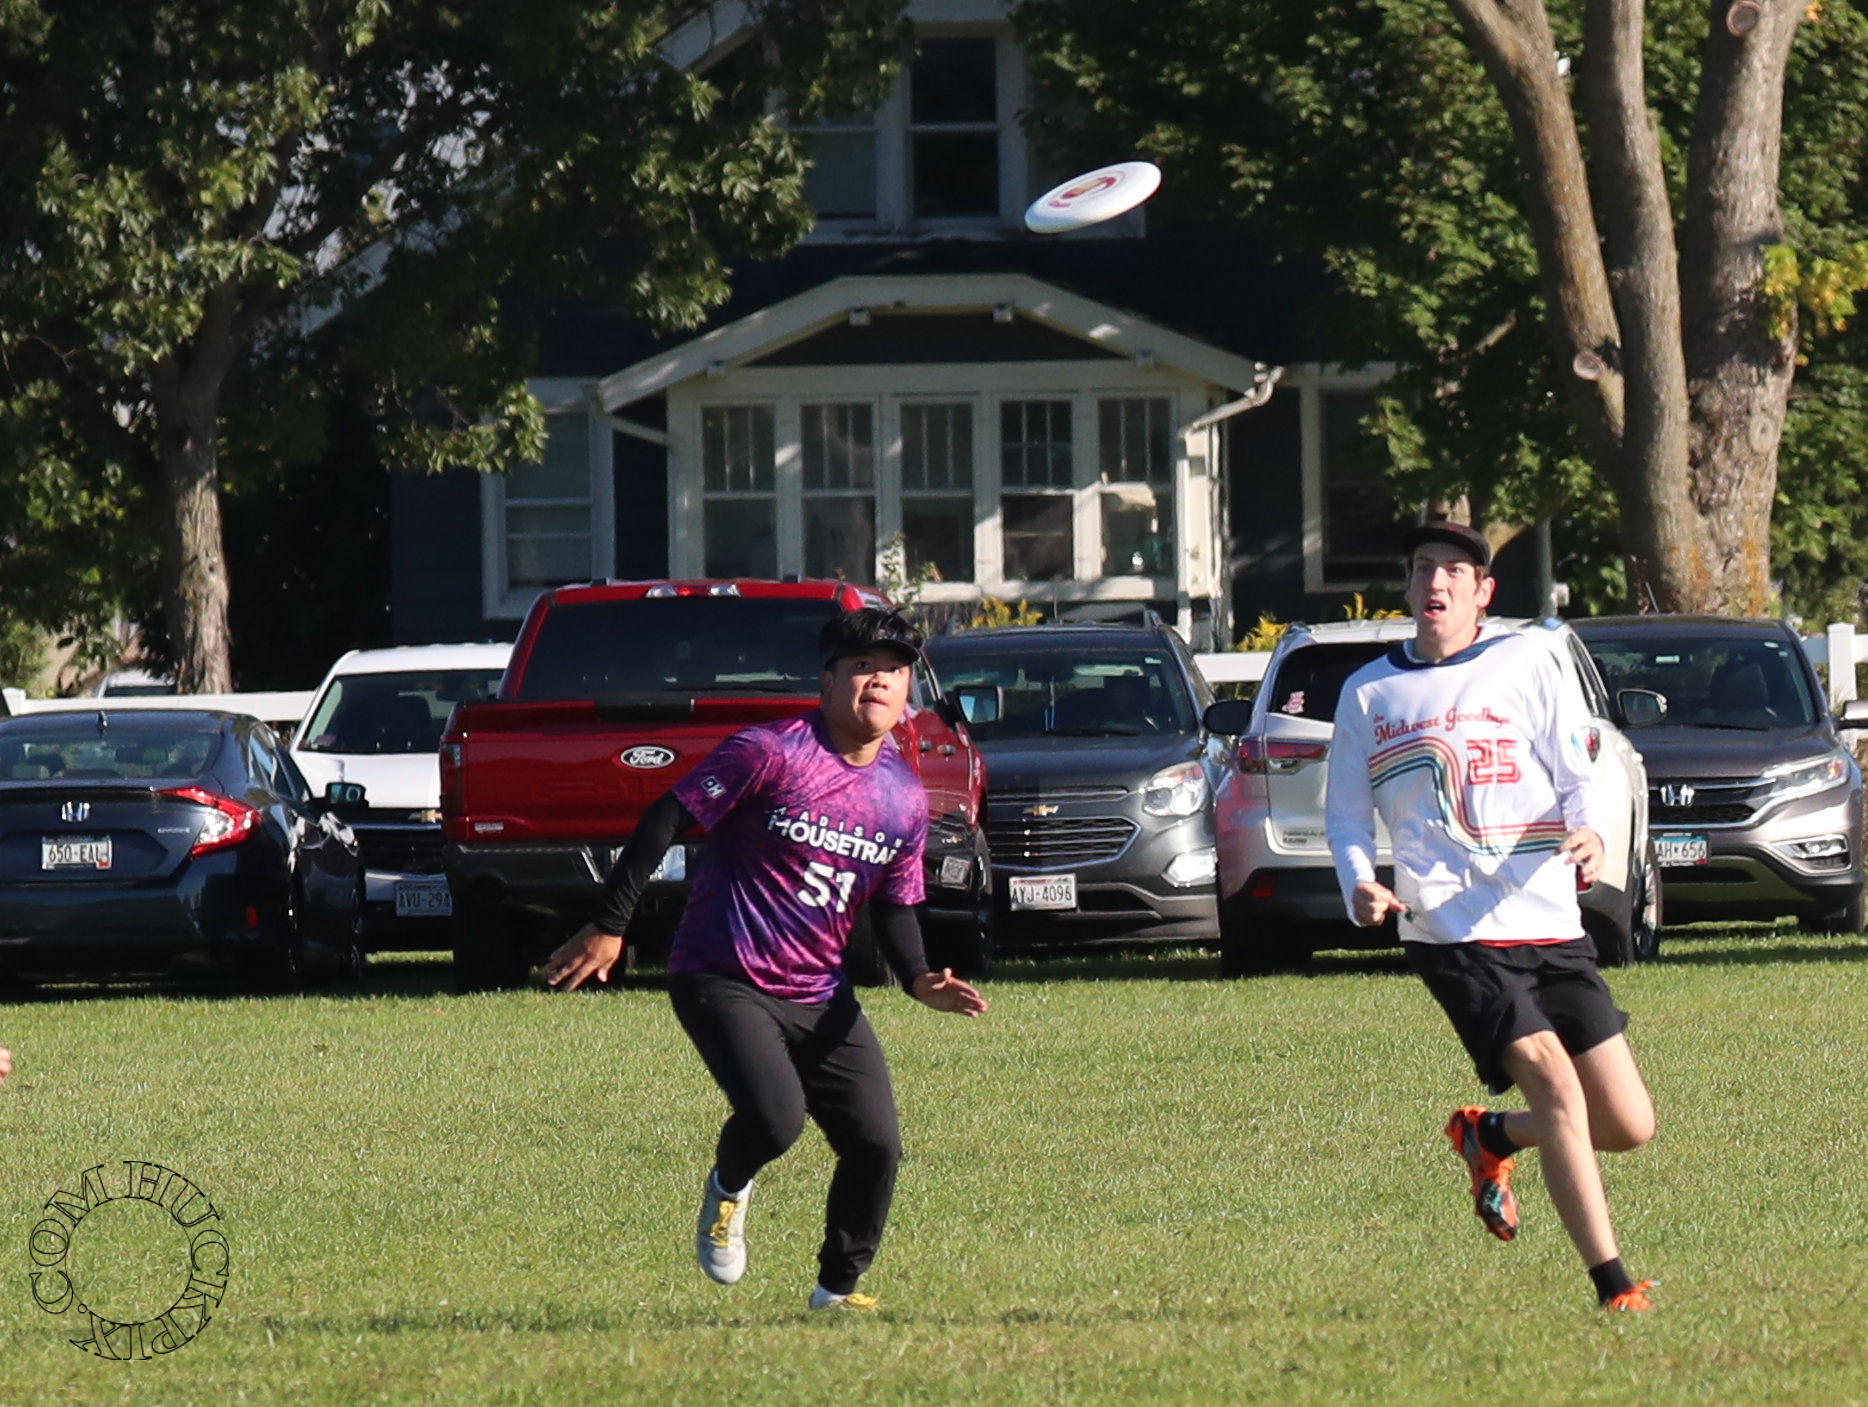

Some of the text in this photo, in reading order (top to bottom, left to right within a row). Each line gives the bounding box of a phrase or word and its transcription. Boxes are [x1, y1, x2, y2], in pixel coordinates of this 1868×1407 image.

[1374, 715, 1440, 745] Midwest
[628, 749, 666, 767] Ford
[1466, 738, 1522, 786] 25
[797, 861, 857, 913] 51
